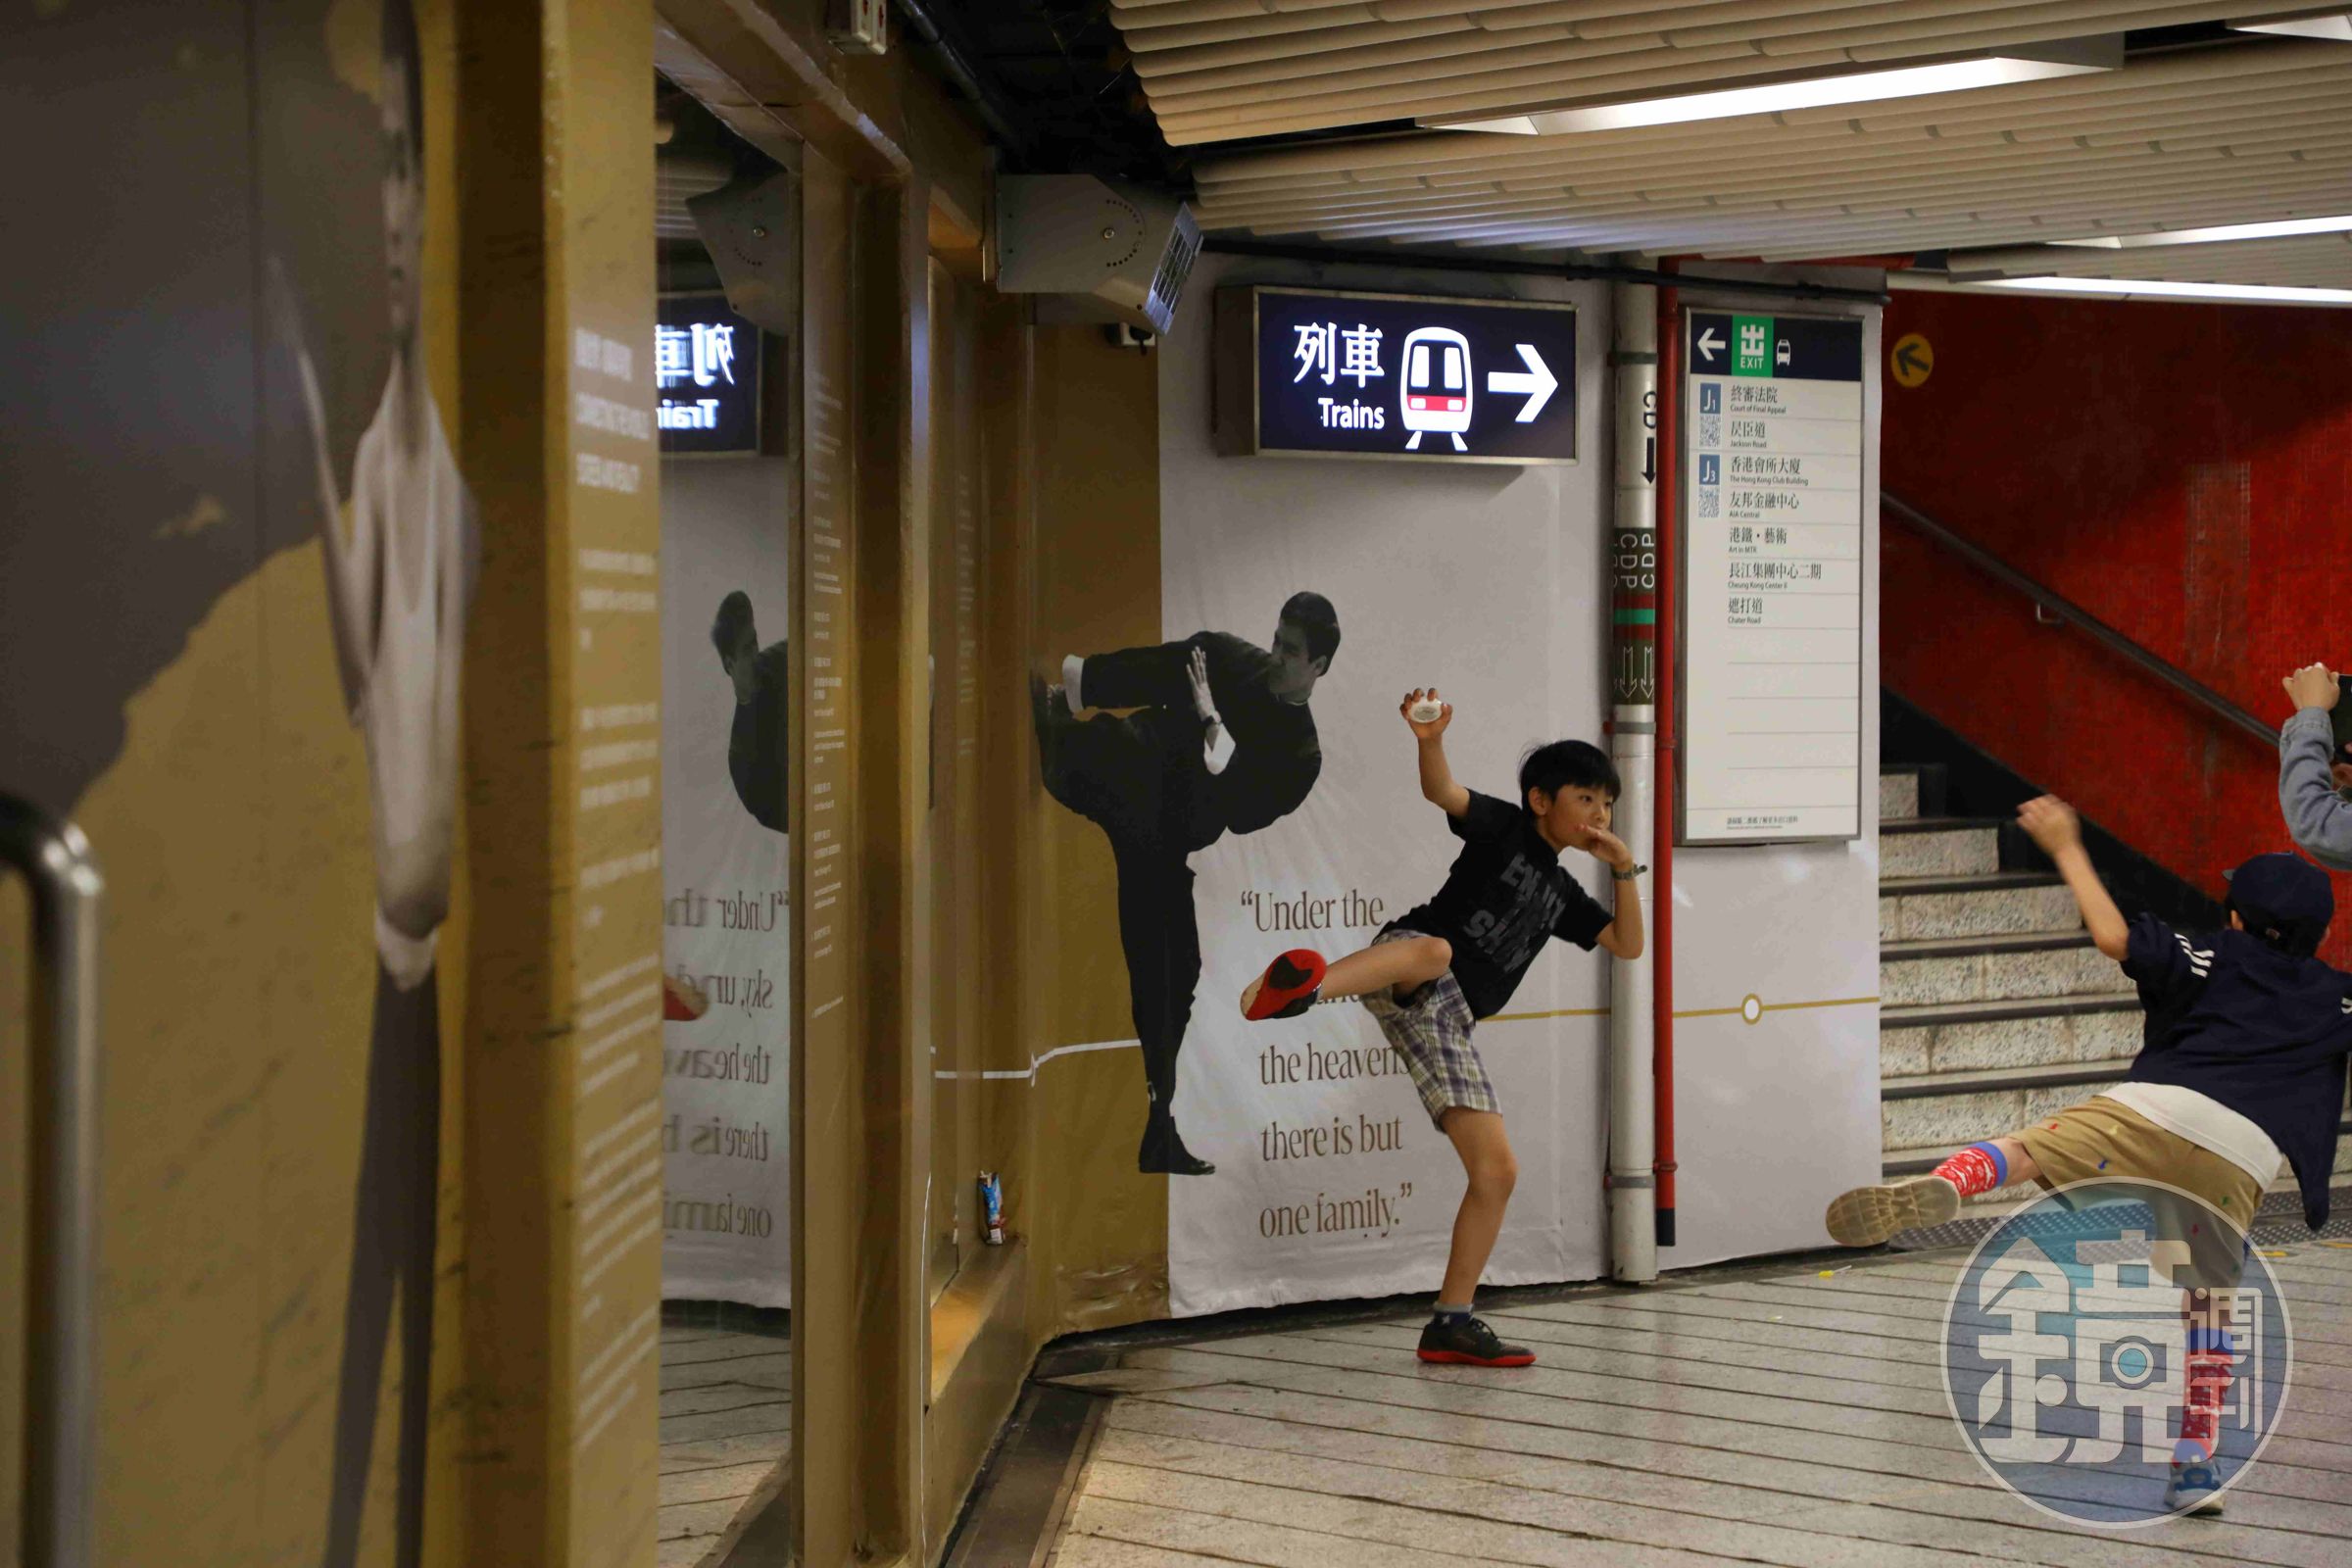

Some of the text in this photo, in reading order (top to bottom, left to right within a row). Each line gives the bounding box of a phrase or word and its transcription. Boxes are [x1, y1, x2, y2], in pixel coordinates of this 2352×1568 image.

[1294, 321, 1385, 388] 列車
[1740, 357, 1764, 369] EXIT
[1703, 388, 1717, 412] J1
[1730, 383, 1779, 404] 終審法院
[1317, 397, 1386, 430] Trains
[1730, 404, 1787, 416] Court of Final Appeal
[1702, 460, 1716, 483] J3
[1731, 456, 1801, 475] 香港會所大廈
[1740, 475, 1756, 484] Hong
[1757, 476, 1772, 485] Kong
[1786, 476, 1809, 486] Building
[1730, 491, 1800, 510] 友邦金融中心
[1740, 510, 1760, 518] Central
[1729, 563, 1822, 580] 長江集團中心二期
[1728, 581, 1749, 590] Cheung
[1749, 582, 1765, 591] Kong
[1728, 597, 1763, 614] 遮打道
[1241, 889, 1385, 932] “Under the
[1259, 1046, 1301, 1086] the
[1261, 1114, 1404, 1162] there is but
[1259, 1182, 1413, 1239] one family.”
